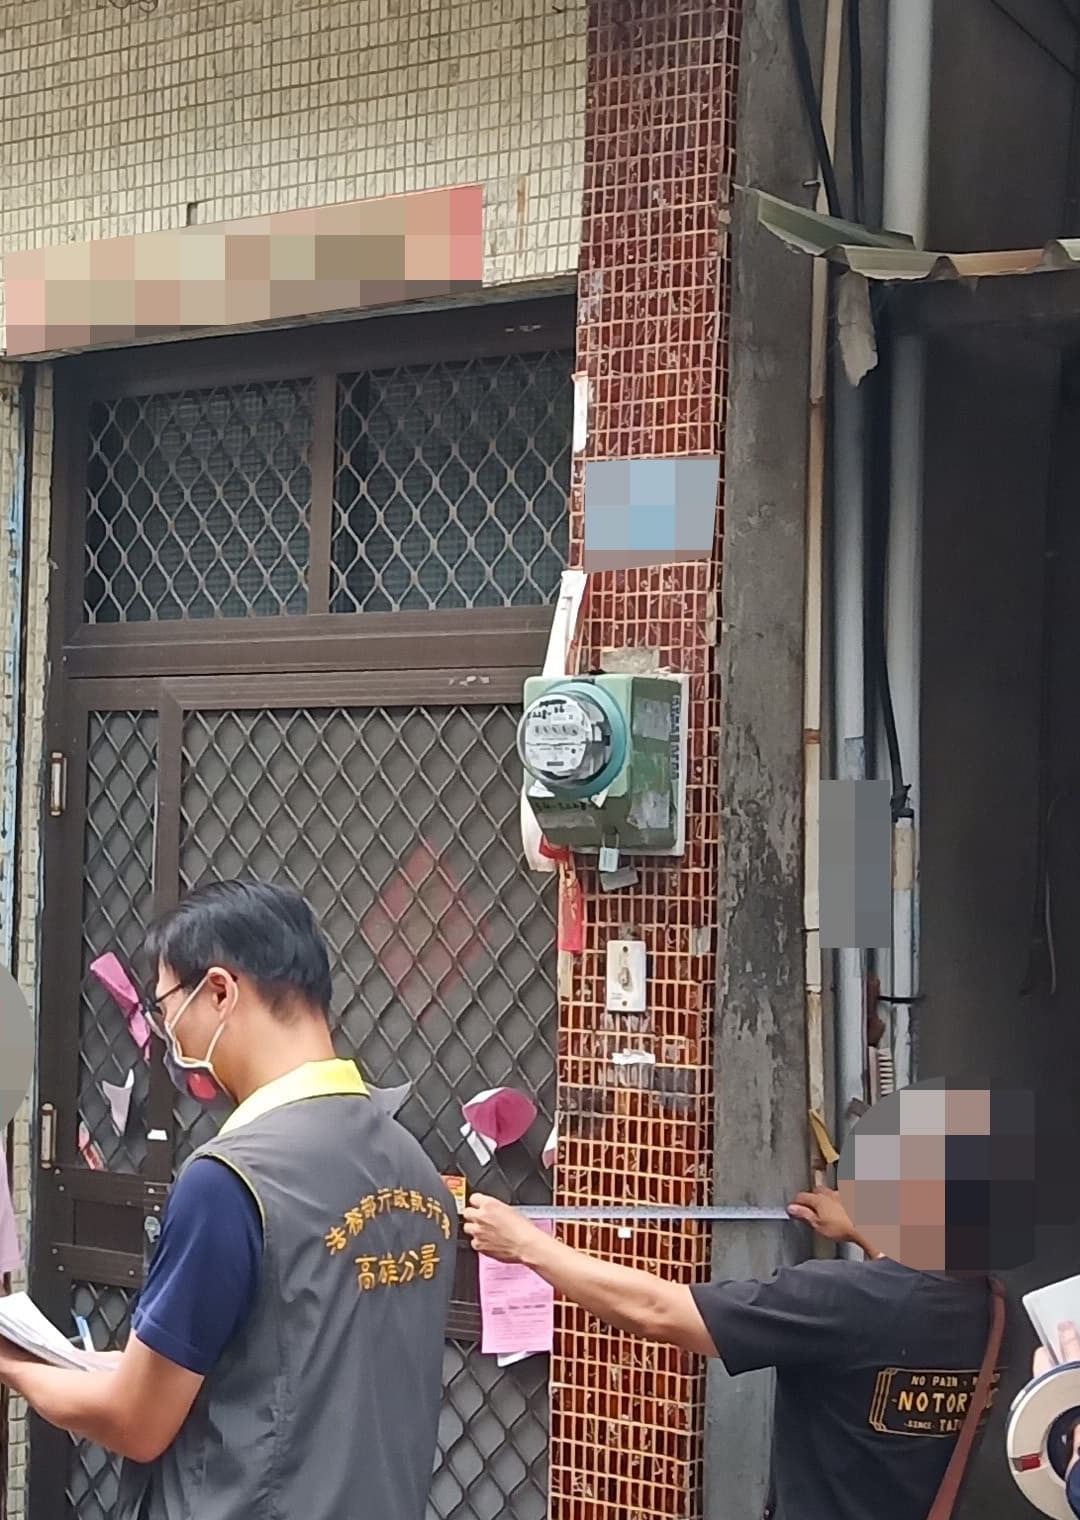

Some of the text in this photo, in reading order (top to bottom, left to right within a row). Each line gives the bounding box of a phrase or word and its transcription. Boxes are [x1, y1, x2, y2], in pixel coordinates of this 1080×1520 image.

[354, 1243, 441, 1290] 高雄分署
[910, 1375, 927, 1386] NO
[932, 1376, 959, 1387] PAIN
[897, 1390, 976, 1414] NOTOR
[906, 1418, 961, 1432] SINCE TAI
